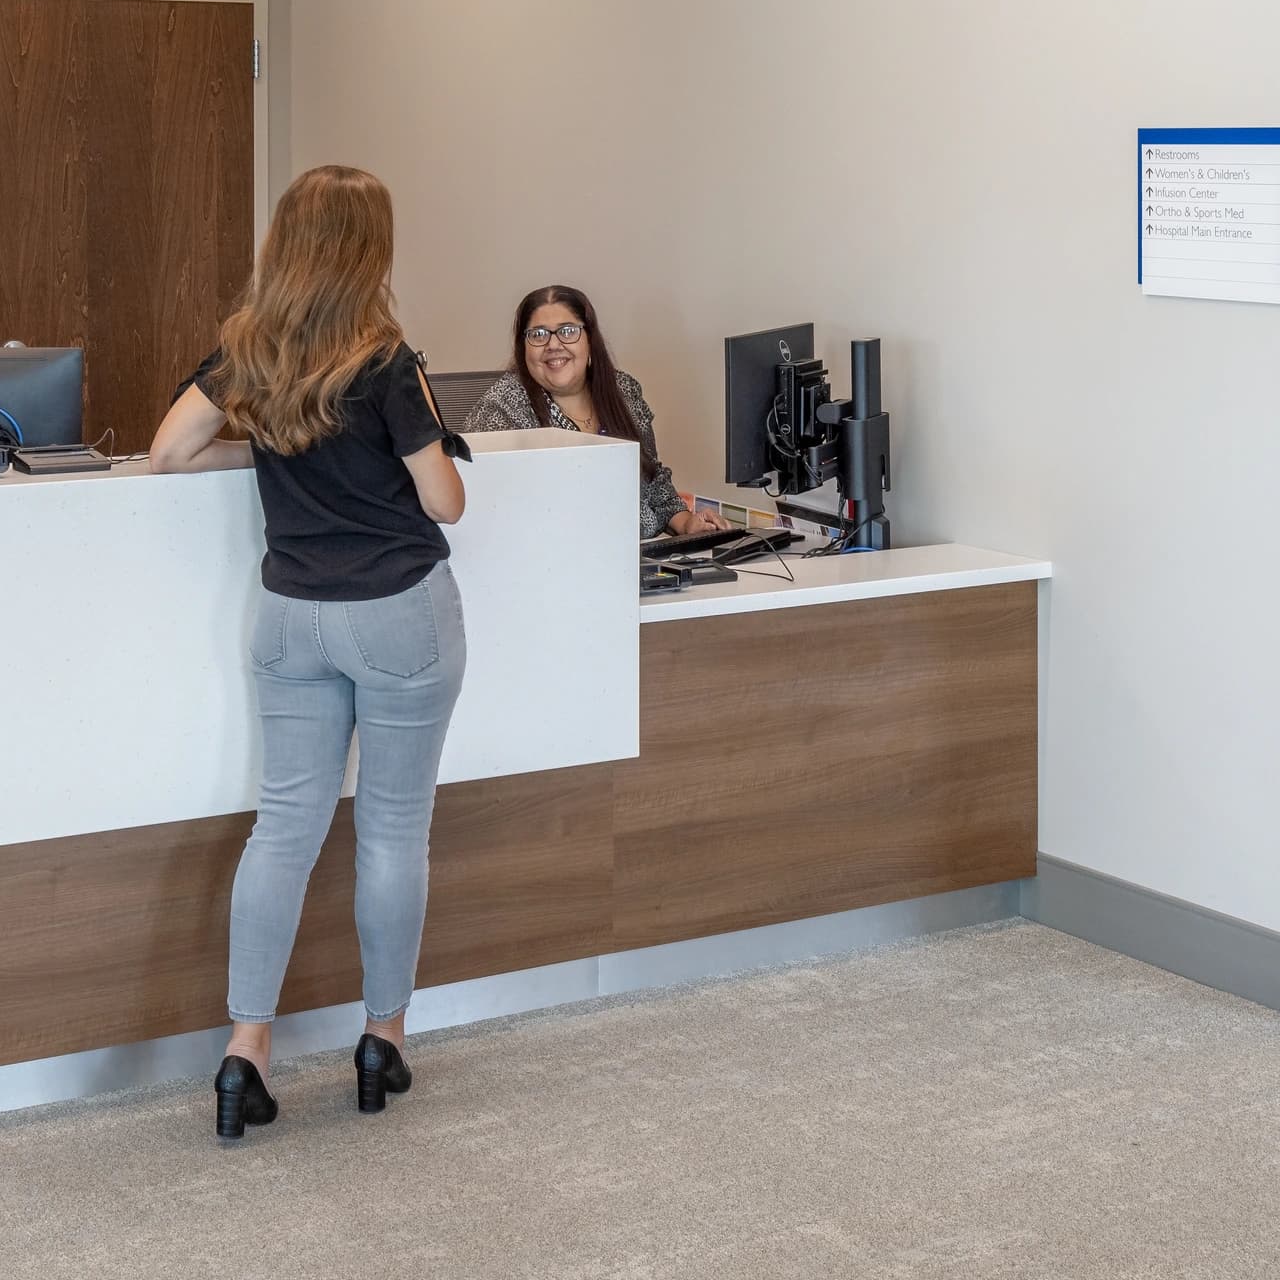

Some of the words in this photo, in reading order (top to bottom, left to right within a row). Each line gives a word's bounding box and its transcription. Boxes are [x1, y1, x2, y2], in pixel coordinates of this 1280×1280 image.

[1155, 149, 1200, 161] Restrooms
[1155, 168, 1195, 180] Women's
[1197, 169, 1204, 180] &
[1207, 168, 1250, 181] Children's
[1155, 187, 1186, 198] Infusion
[1189, 187, 1218, 199] Center
[1155, 205, 1182, 217] Ortho
[1184, 207, 1191, 217] &
[1194, 207, 1222, 220] Sports
[1224, 208, 1245, 219] Med
[1155, 225, 1189, 238] Hospital
[1191, 226, 1212, 237] Main
[1214, 227, 1253, 239] Entrance
